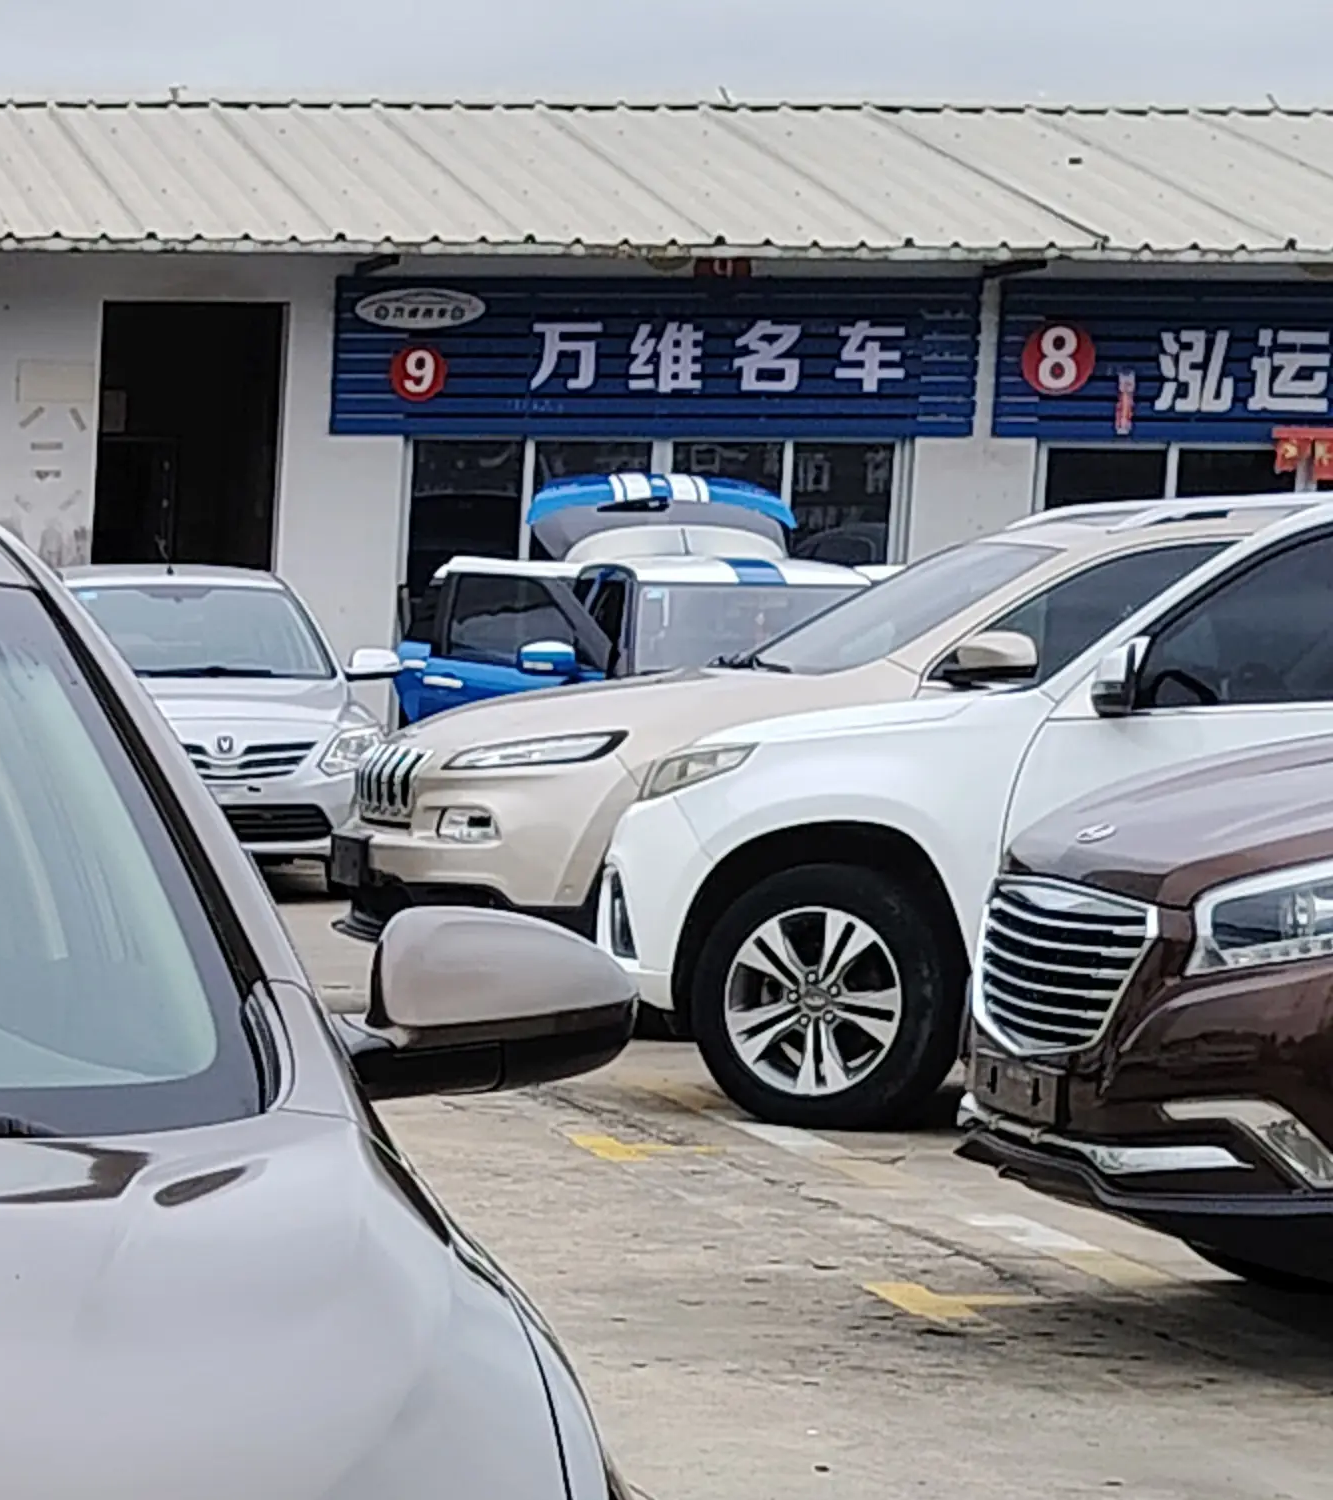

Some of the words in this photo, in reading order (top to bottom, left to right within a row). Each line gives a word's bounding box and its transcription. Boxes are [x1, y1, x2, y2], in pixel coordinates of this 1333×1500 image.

[403, 349, 436, 394] 9
[530, 319, 908, 392] 万维名车
[1037, 325, 1080, 390] 8
[1154, 328, 1331, 413] 泓运
